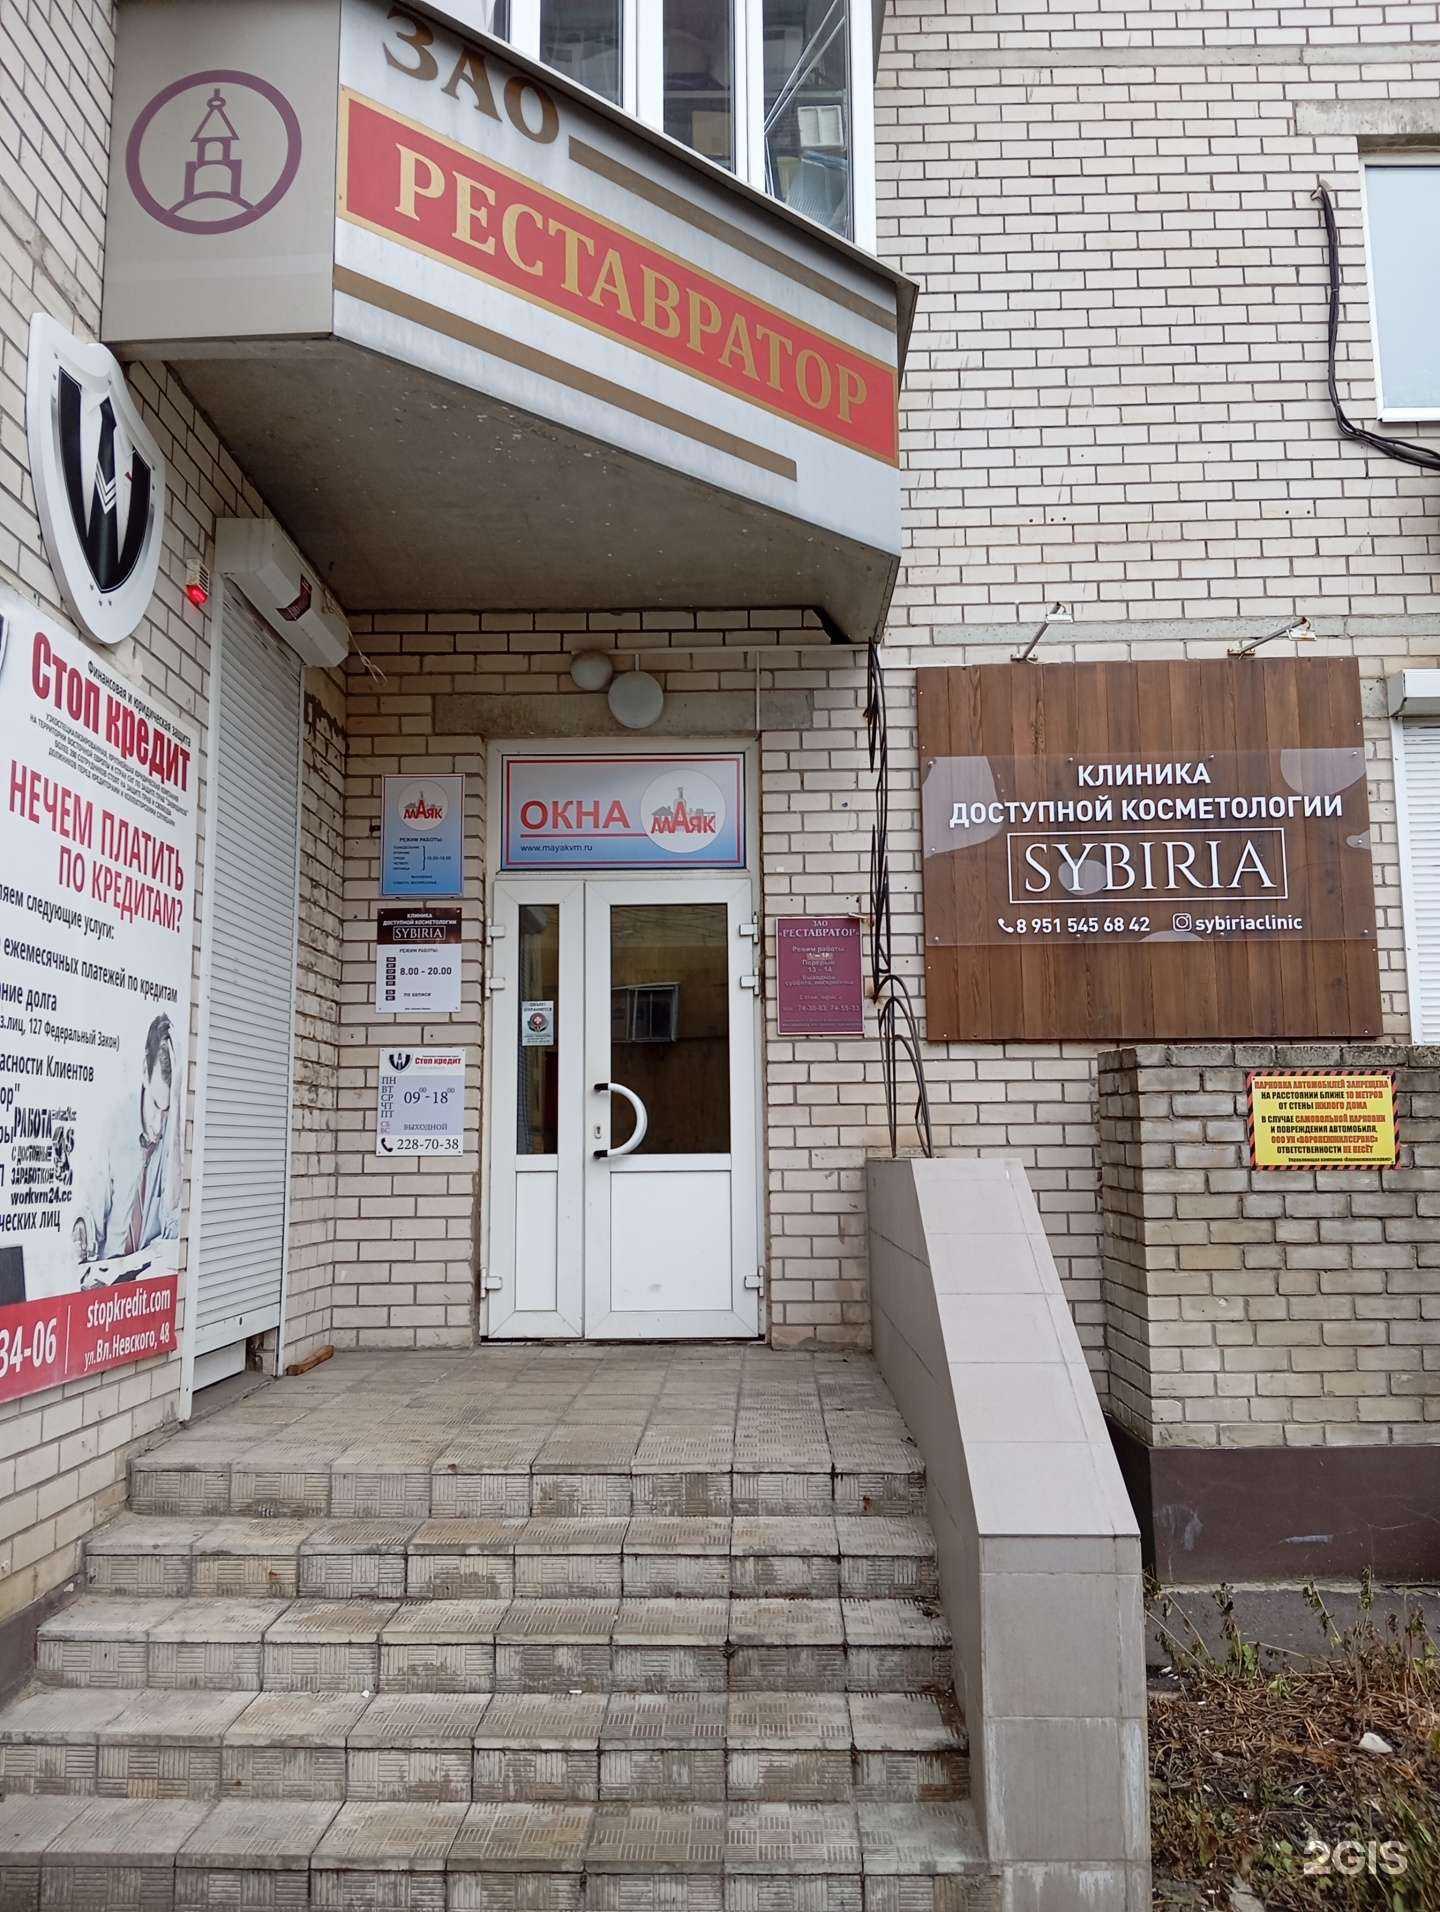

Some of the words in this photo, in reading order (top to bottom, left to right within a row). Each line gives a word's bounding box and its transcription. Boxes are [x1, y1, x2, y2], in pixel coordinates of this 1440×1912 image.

[383, 8, 560, 144] ЗАО
[394, 143, 867, 423] РЕСТАВРАТОР
[32, 632, 101, 735] Стоп
[106, 695, 190, 792] кредит
[1077, 762, 1212, 787] КЛИНИКА
[9, 760, 93, 849] НЕЧЕМ
[101, 809, 184, 891] ПЛАТИТЬ
[520, 799, 631, 830] ОКНА
[949, 796, 1113, 828] ДОСТУПНОЙ
[1122, 795, 1343, 822] КОСМЕТОЛОГИИ
[1024, 839, 1277, 893] SYBIRIA
[59, 845, 84, 893] ПО
[92, 861, 183, 934] КРЕДИТАМ?
[26, 895, 82, 929] следующие
[84, 915, 115, 940] услуги:
[1016, 919, 1026, 933] 8
[1031, 918, 1061, 933] 951
[1068, 917, 1099, 933] 545
[1104, 917, 1125, 932] 68
[1129, 916, 1150, 932] 42
[1195, 914, 1303, 935] sybiriaclinic
[395, 927, 442, 938] SYBIRIA
[4, 938, 79, 975] ежемесячных
[81, 961, 126, 988] платежей
[128, 974, 138, 992] по
[140, 978, 178, 1003] кредитам
[400, 967, 419, 975] 8.00
[427, 967, 452, 975] 20.00
[0, 982, 23, 1004] ние
[26, 989, 57, 1012] долга
[29, 1017, 42, 1035] 127
[44, 1021, 96, 1046] Федеральный
[0, 1053, 43, 1076] асности
[46, 1055, 94, 1082] Клиентов
[382, 1076, 396, 1085] ПН
[381, 1094, 394, 1102] СР
[1261, 1091, 1271, 1099] НА
[1272, 1091, 1319, 1099] РАССТОЯНИИ
[1320, 1091, 1344, 1099] БЛИЖЕ
[1346, 1091, 1354, 1099] 10
[1355, 1091, 1383, 1099] МЕТРОВ
[1346, 1102, 1367, 1110] ДОМА
[1261, 1115, 1266, 1123] В
[1268, 1115, 1294, 1123] СЛУЧАЕ
[1276, 1126, 1328, 1134] ПОВРЕЖДЕНИЯ
[397, 1138, 459, 1150] 228-70-38
[1277, 1146, 1342, 1154] ОТВЕТСТВЕННОСТИ
[40, 1211, 60, 1232] лиц
[87, 1288, 171, 1332] stopkredit.com
[84, 1330, 157, 1371] ул.Вл.Невского,
[160, 1322, 170, 1343] 48
